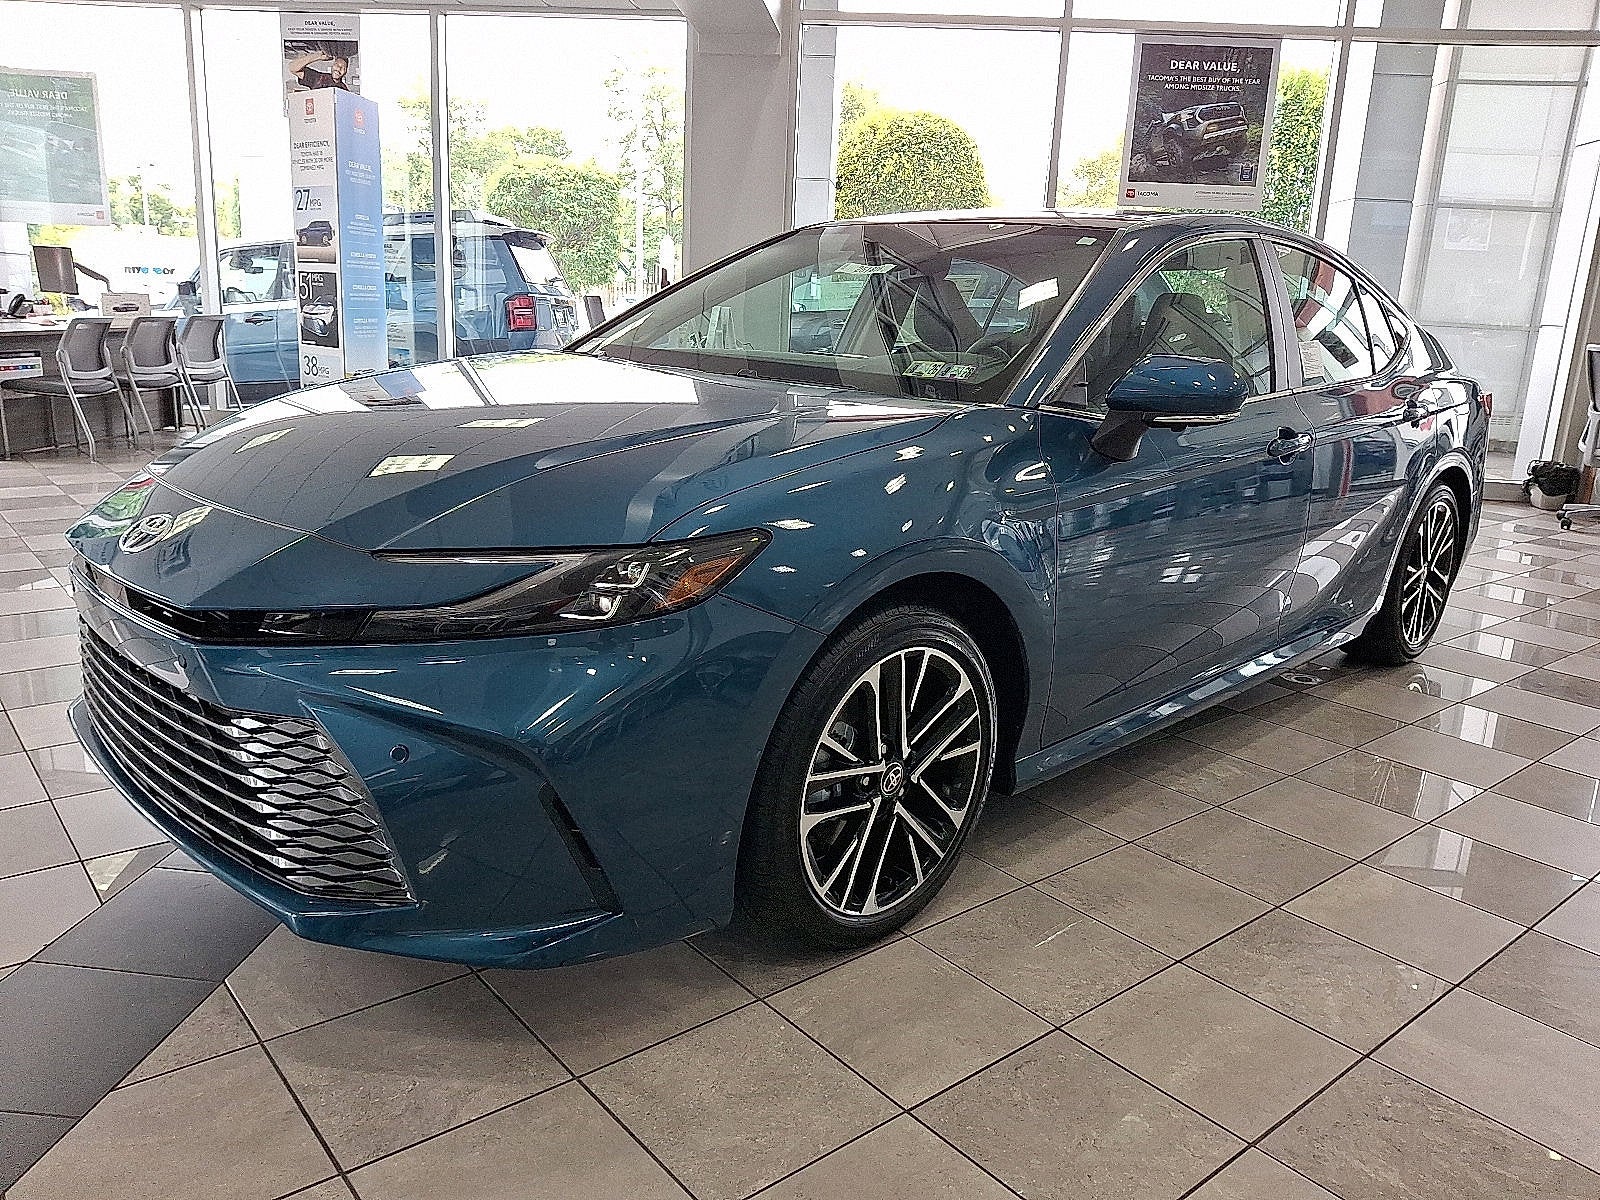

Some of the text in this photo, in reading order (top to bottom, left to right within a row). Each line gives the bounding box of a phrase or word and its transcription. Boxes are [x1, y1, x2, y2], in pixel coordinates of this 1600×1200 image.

[1170, 59, 1241, 74] DEAR VALUE,
[1147, 74, 1179, 82] TACOMA'S
[1180, 75, 1191, 83] THE
[1208, 76, 1220, 84] BUY
[1190, 83, 1215, 91] MIDSIZE
[295, 188, 311, 211] 27
[309, 198, 322, 207] MPG
[312, 272, 324, 282] MPG
[299, 272, 313, 300] 51
[303, 355, 319, 376] 38
[317, 366, 330, 375] MPG
